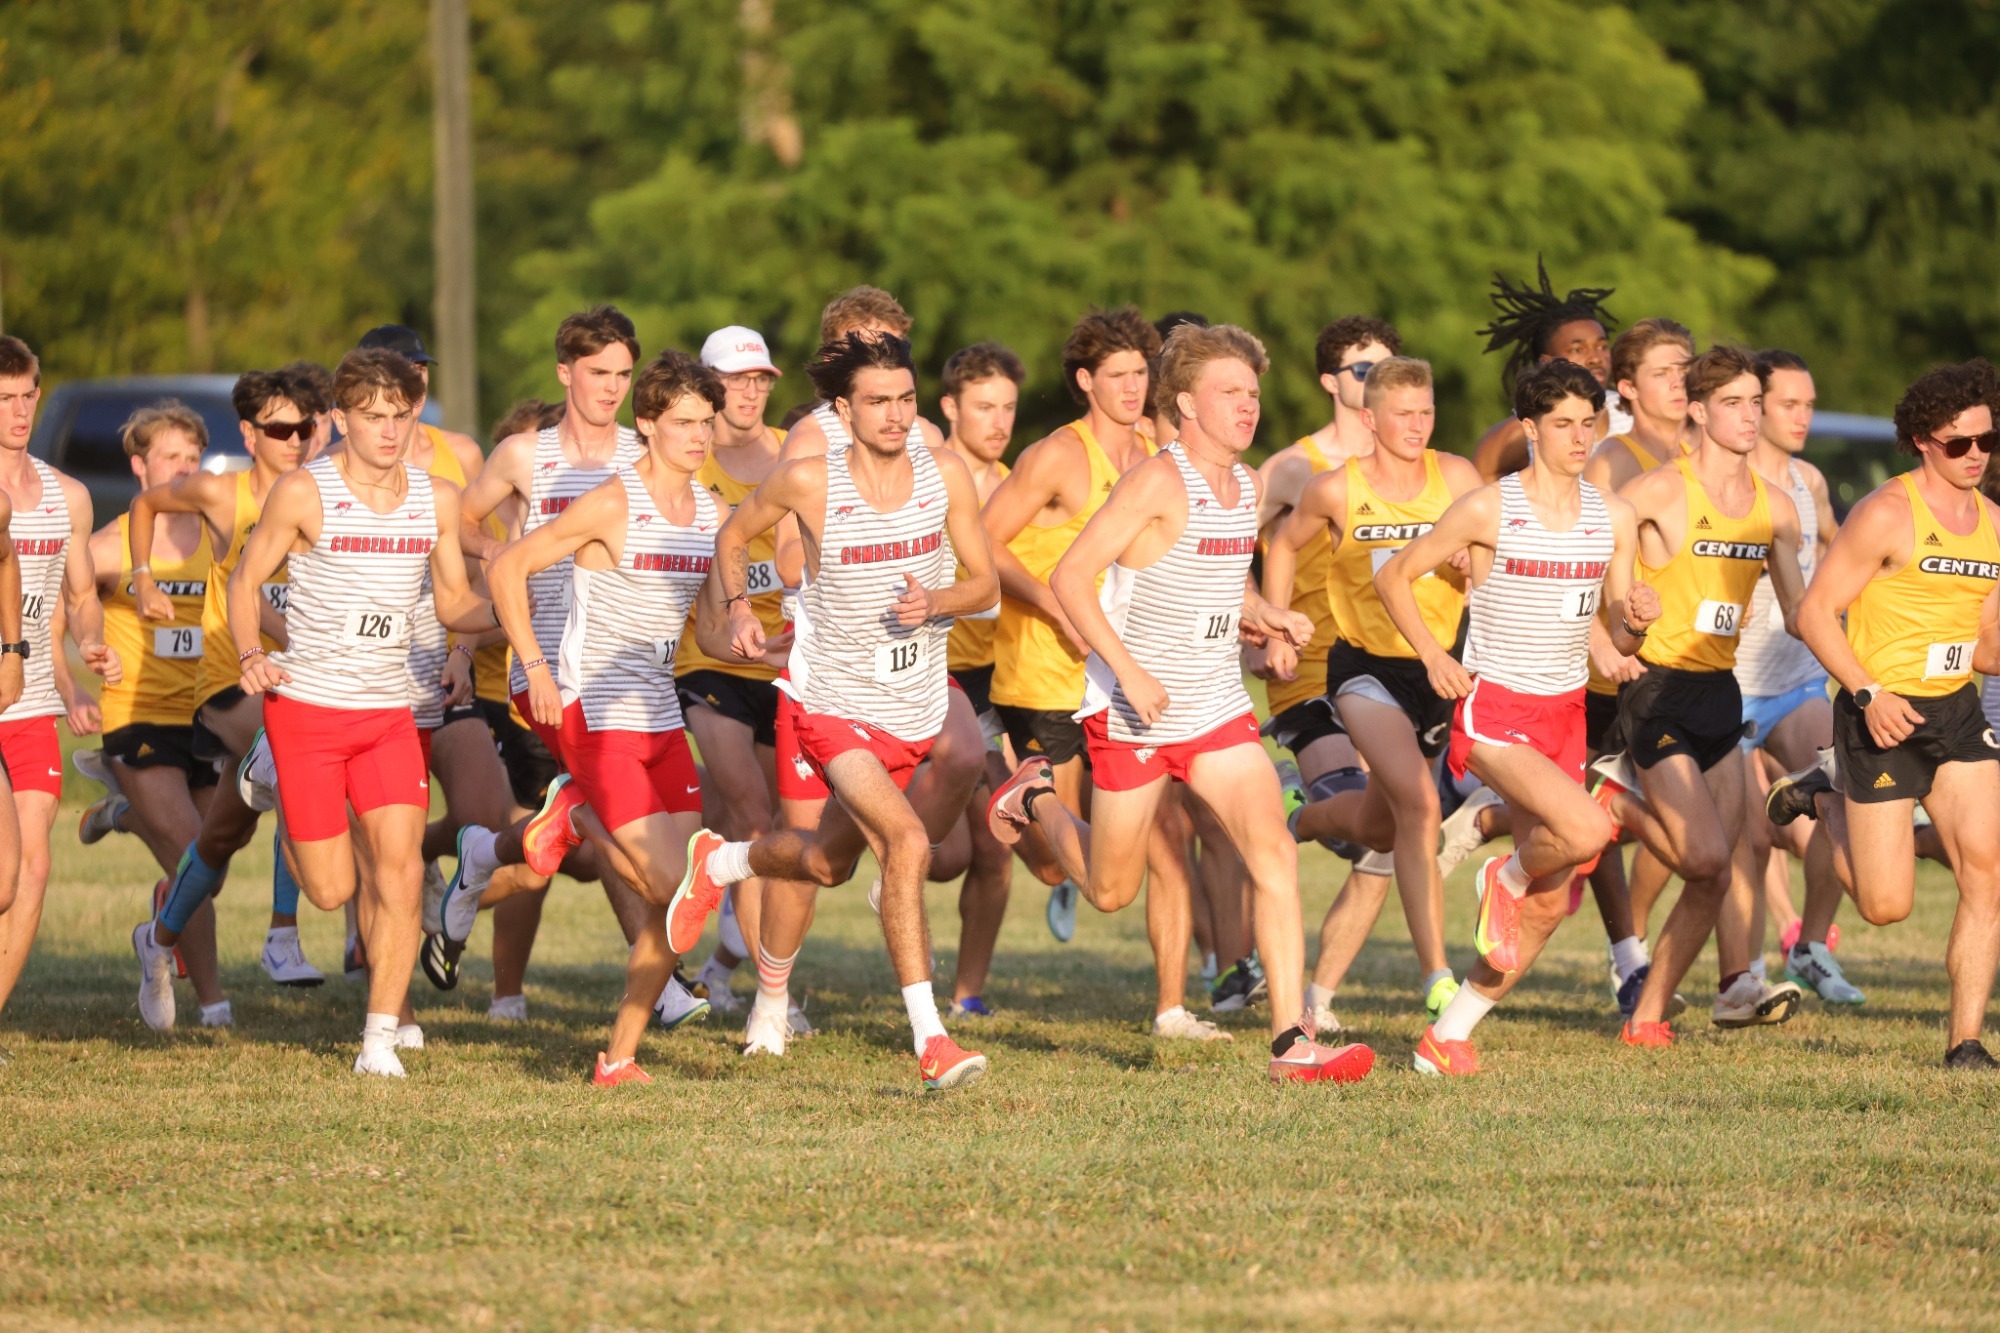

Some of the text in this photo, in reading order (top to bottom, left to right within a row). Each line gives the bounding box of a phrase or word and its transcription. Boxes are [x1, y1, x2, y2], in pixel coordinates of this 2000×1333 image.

[735, 342, 764, 353] USA
[541, 496, 577, 514] CUM
[1353, 522, 1435, 541] CENTR
[330, 535, 432, 554] CUMBERLANDS
[1692, 539, 1769, 560] CENTRE
[747, 563, 771, 589] 88
[1919, 555, 2000, 580] CENTRE
[1576, 589, 1595, 617] 12
[356, 613, 392, 639] 126
[1204, 613, 1230, 639] 114
[1714, 605, 1735, 630] 68
[171, 628, 193, 652] 79
[890, 642, 918, 672] 113
[1944, 644, 1963, 671] 91
